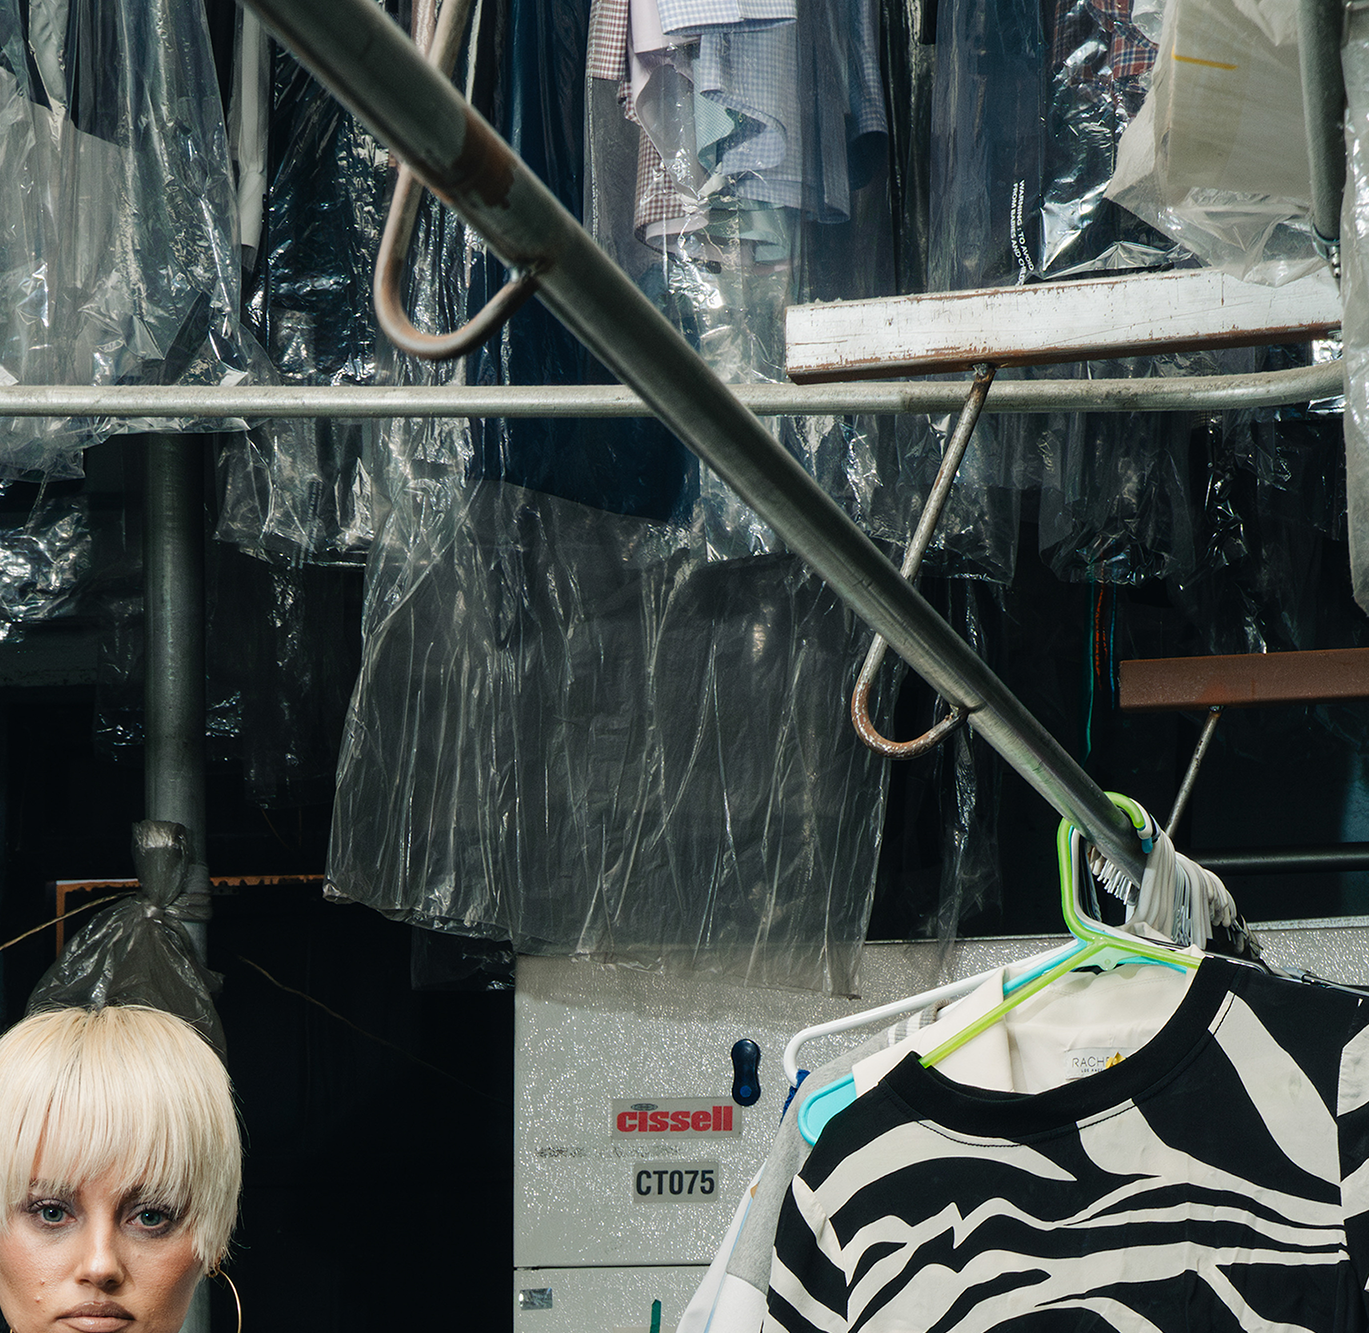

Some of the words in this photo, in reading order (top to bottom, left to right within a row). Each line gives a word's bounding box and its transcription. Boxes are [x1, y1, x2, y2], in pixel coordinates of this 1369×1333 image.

[1011, 183, 1019, 208] FROM
[1017, 179, 1025, 226] WARNING
[1011, 240, 1022, 258] AND
[1018, 231, 1026, 245] TO
[1020, 246, 1035, 271] AVOID
[617, 1106, 733, 1132] cissell
[636, 1170, 715, 1196] CT075
